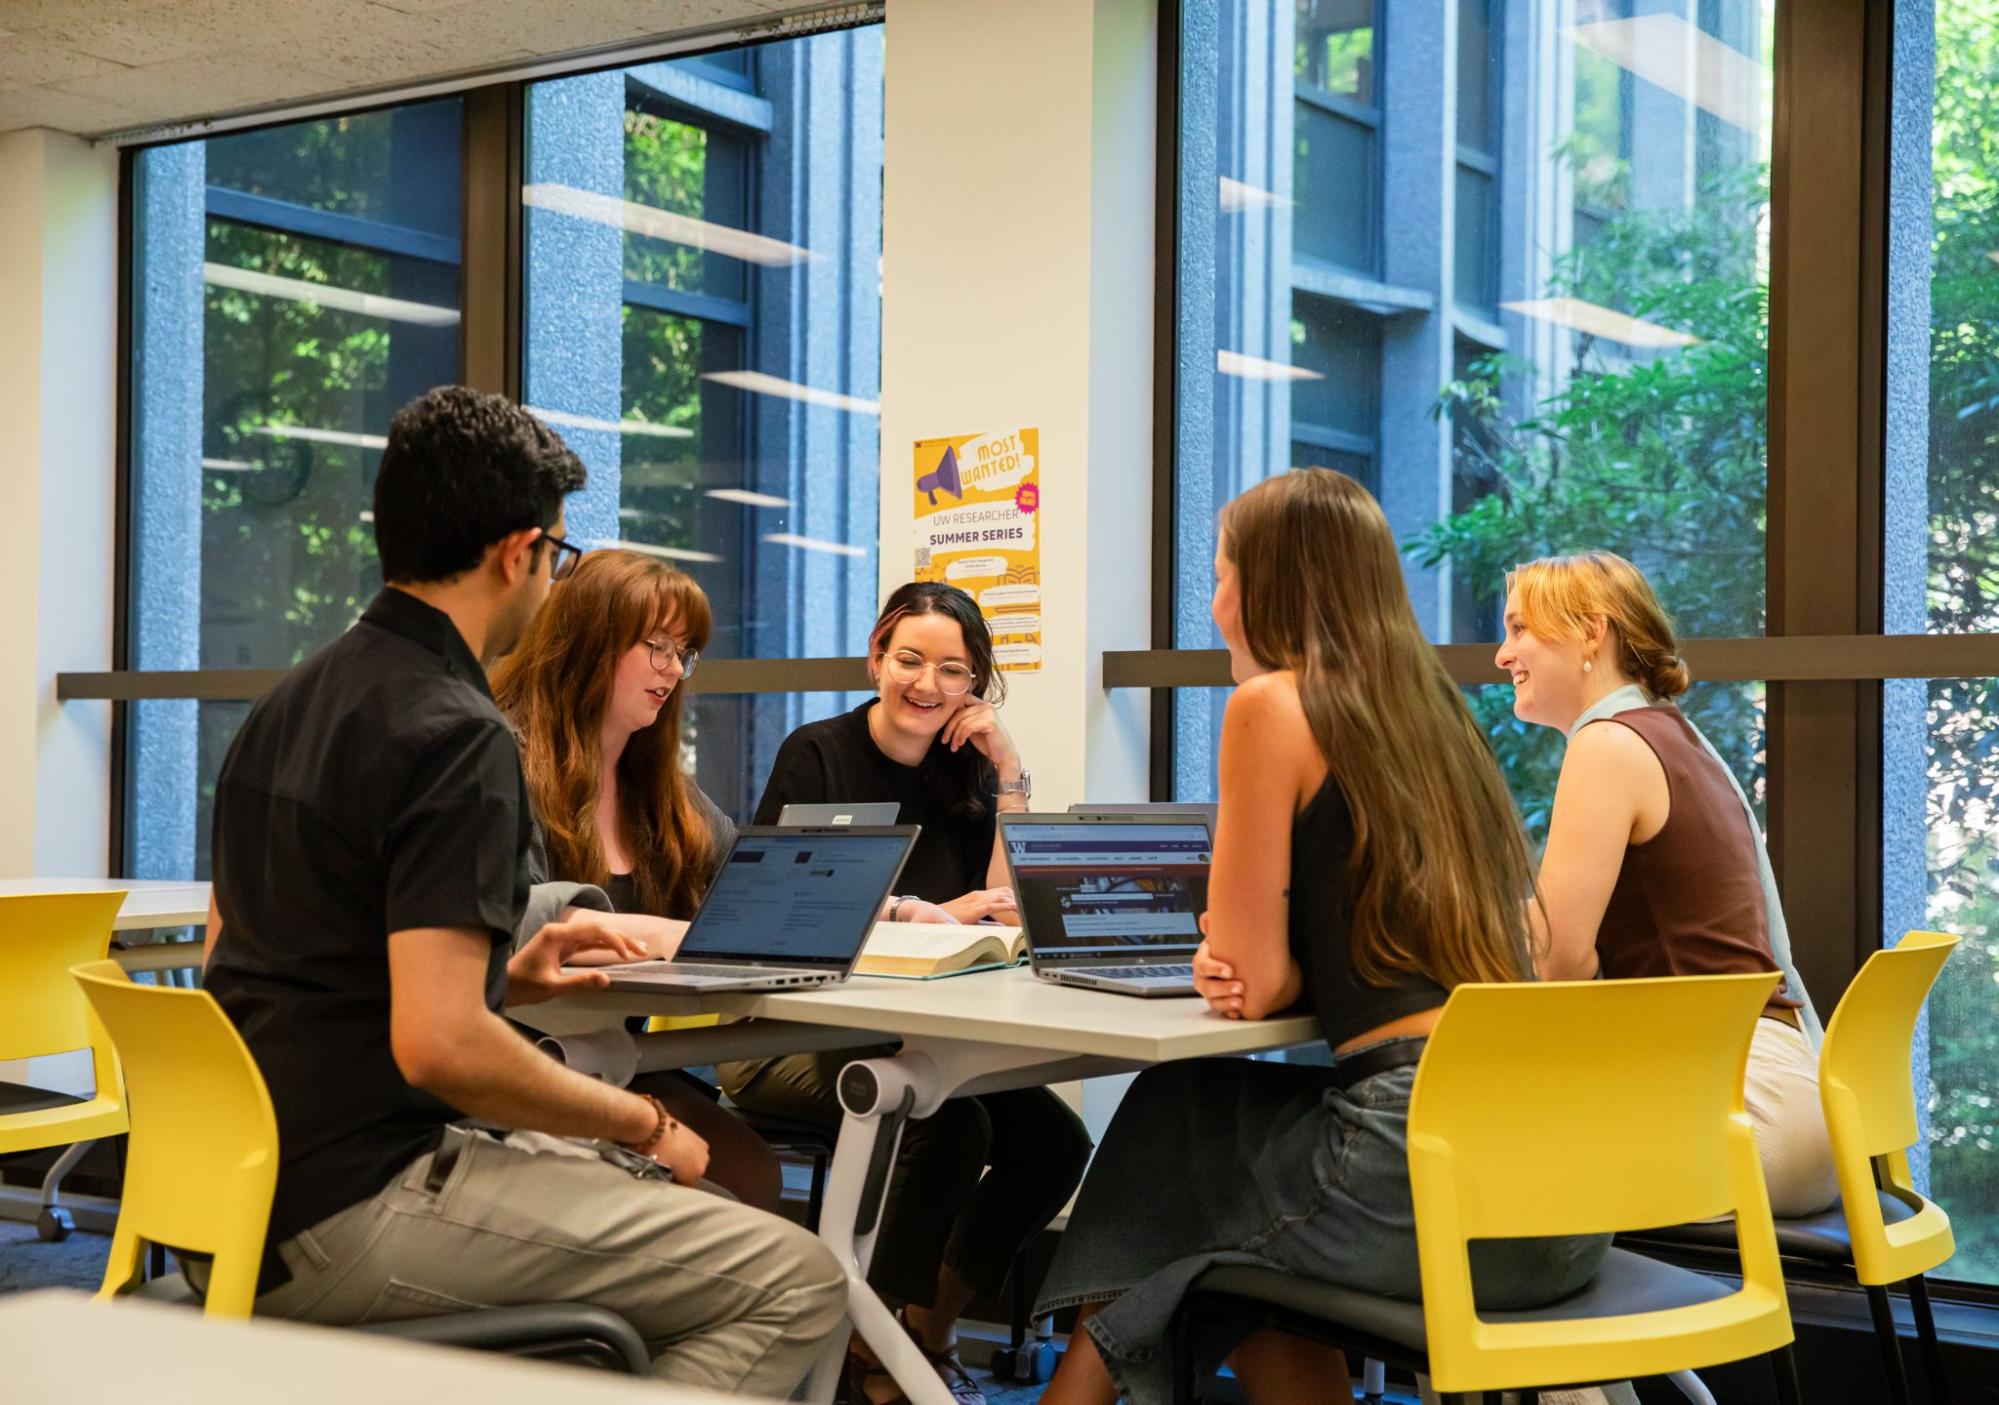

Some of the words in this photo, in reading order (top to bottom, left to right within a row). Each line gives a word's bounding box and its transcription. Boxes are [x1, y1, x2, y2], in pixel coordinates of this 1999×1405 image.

[978, 435, 1015, 461] MOST
[961, 454, 1020, 485] WANTED!
[933, 514, 952, 526] UW
[953, 509, 1019, 524] RESEARCHER
[930, 531, 979, 545] SUMMER
[982, 527, 1023, 541] SERIES
[1010, 842, 1026, 856] W
